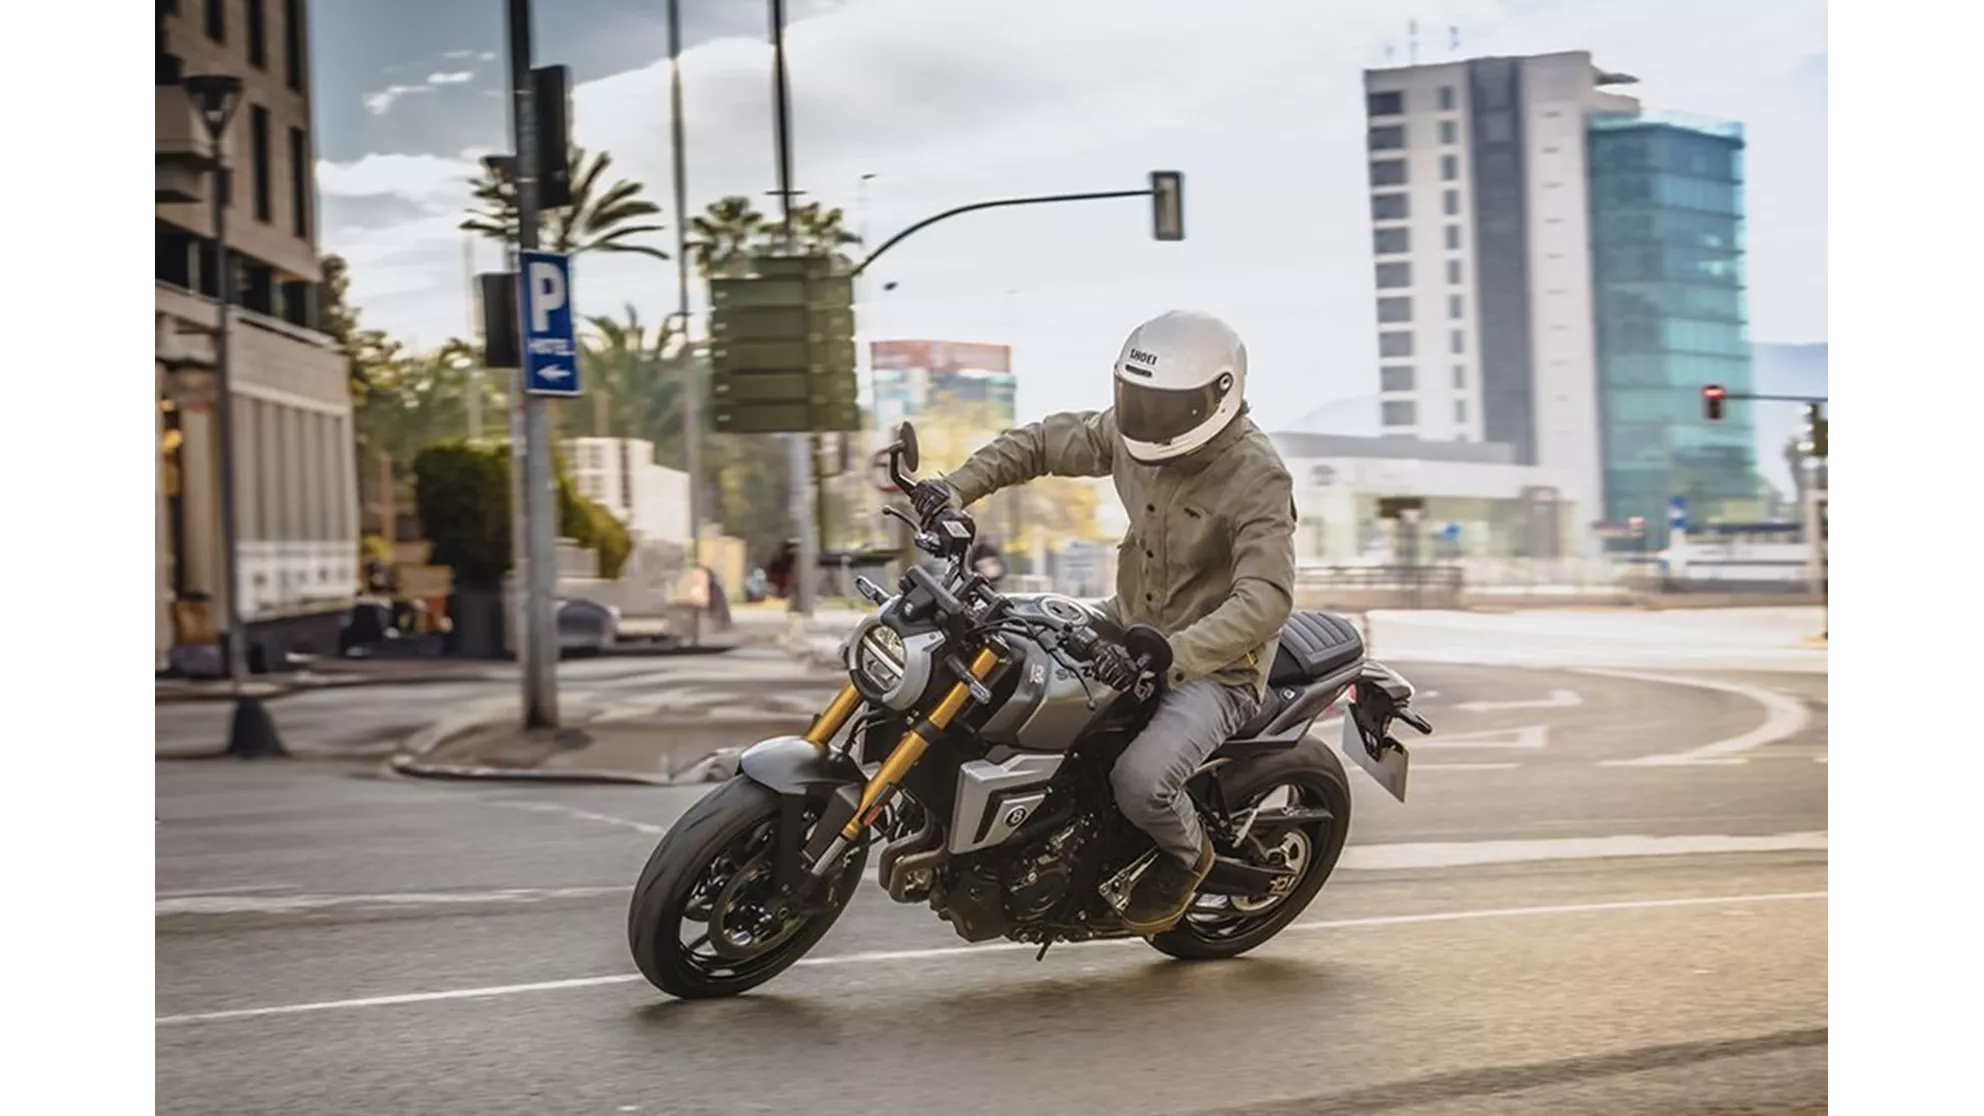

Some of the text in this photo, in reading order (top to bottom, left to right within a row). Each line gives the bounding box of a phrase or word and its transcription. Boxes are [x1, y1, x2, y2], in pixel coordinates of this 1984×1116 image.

[529, 262, 566, 332] P
[1130, 348, 1157, 365] SHOEI
[1010, 809, 1024, 824] 8
